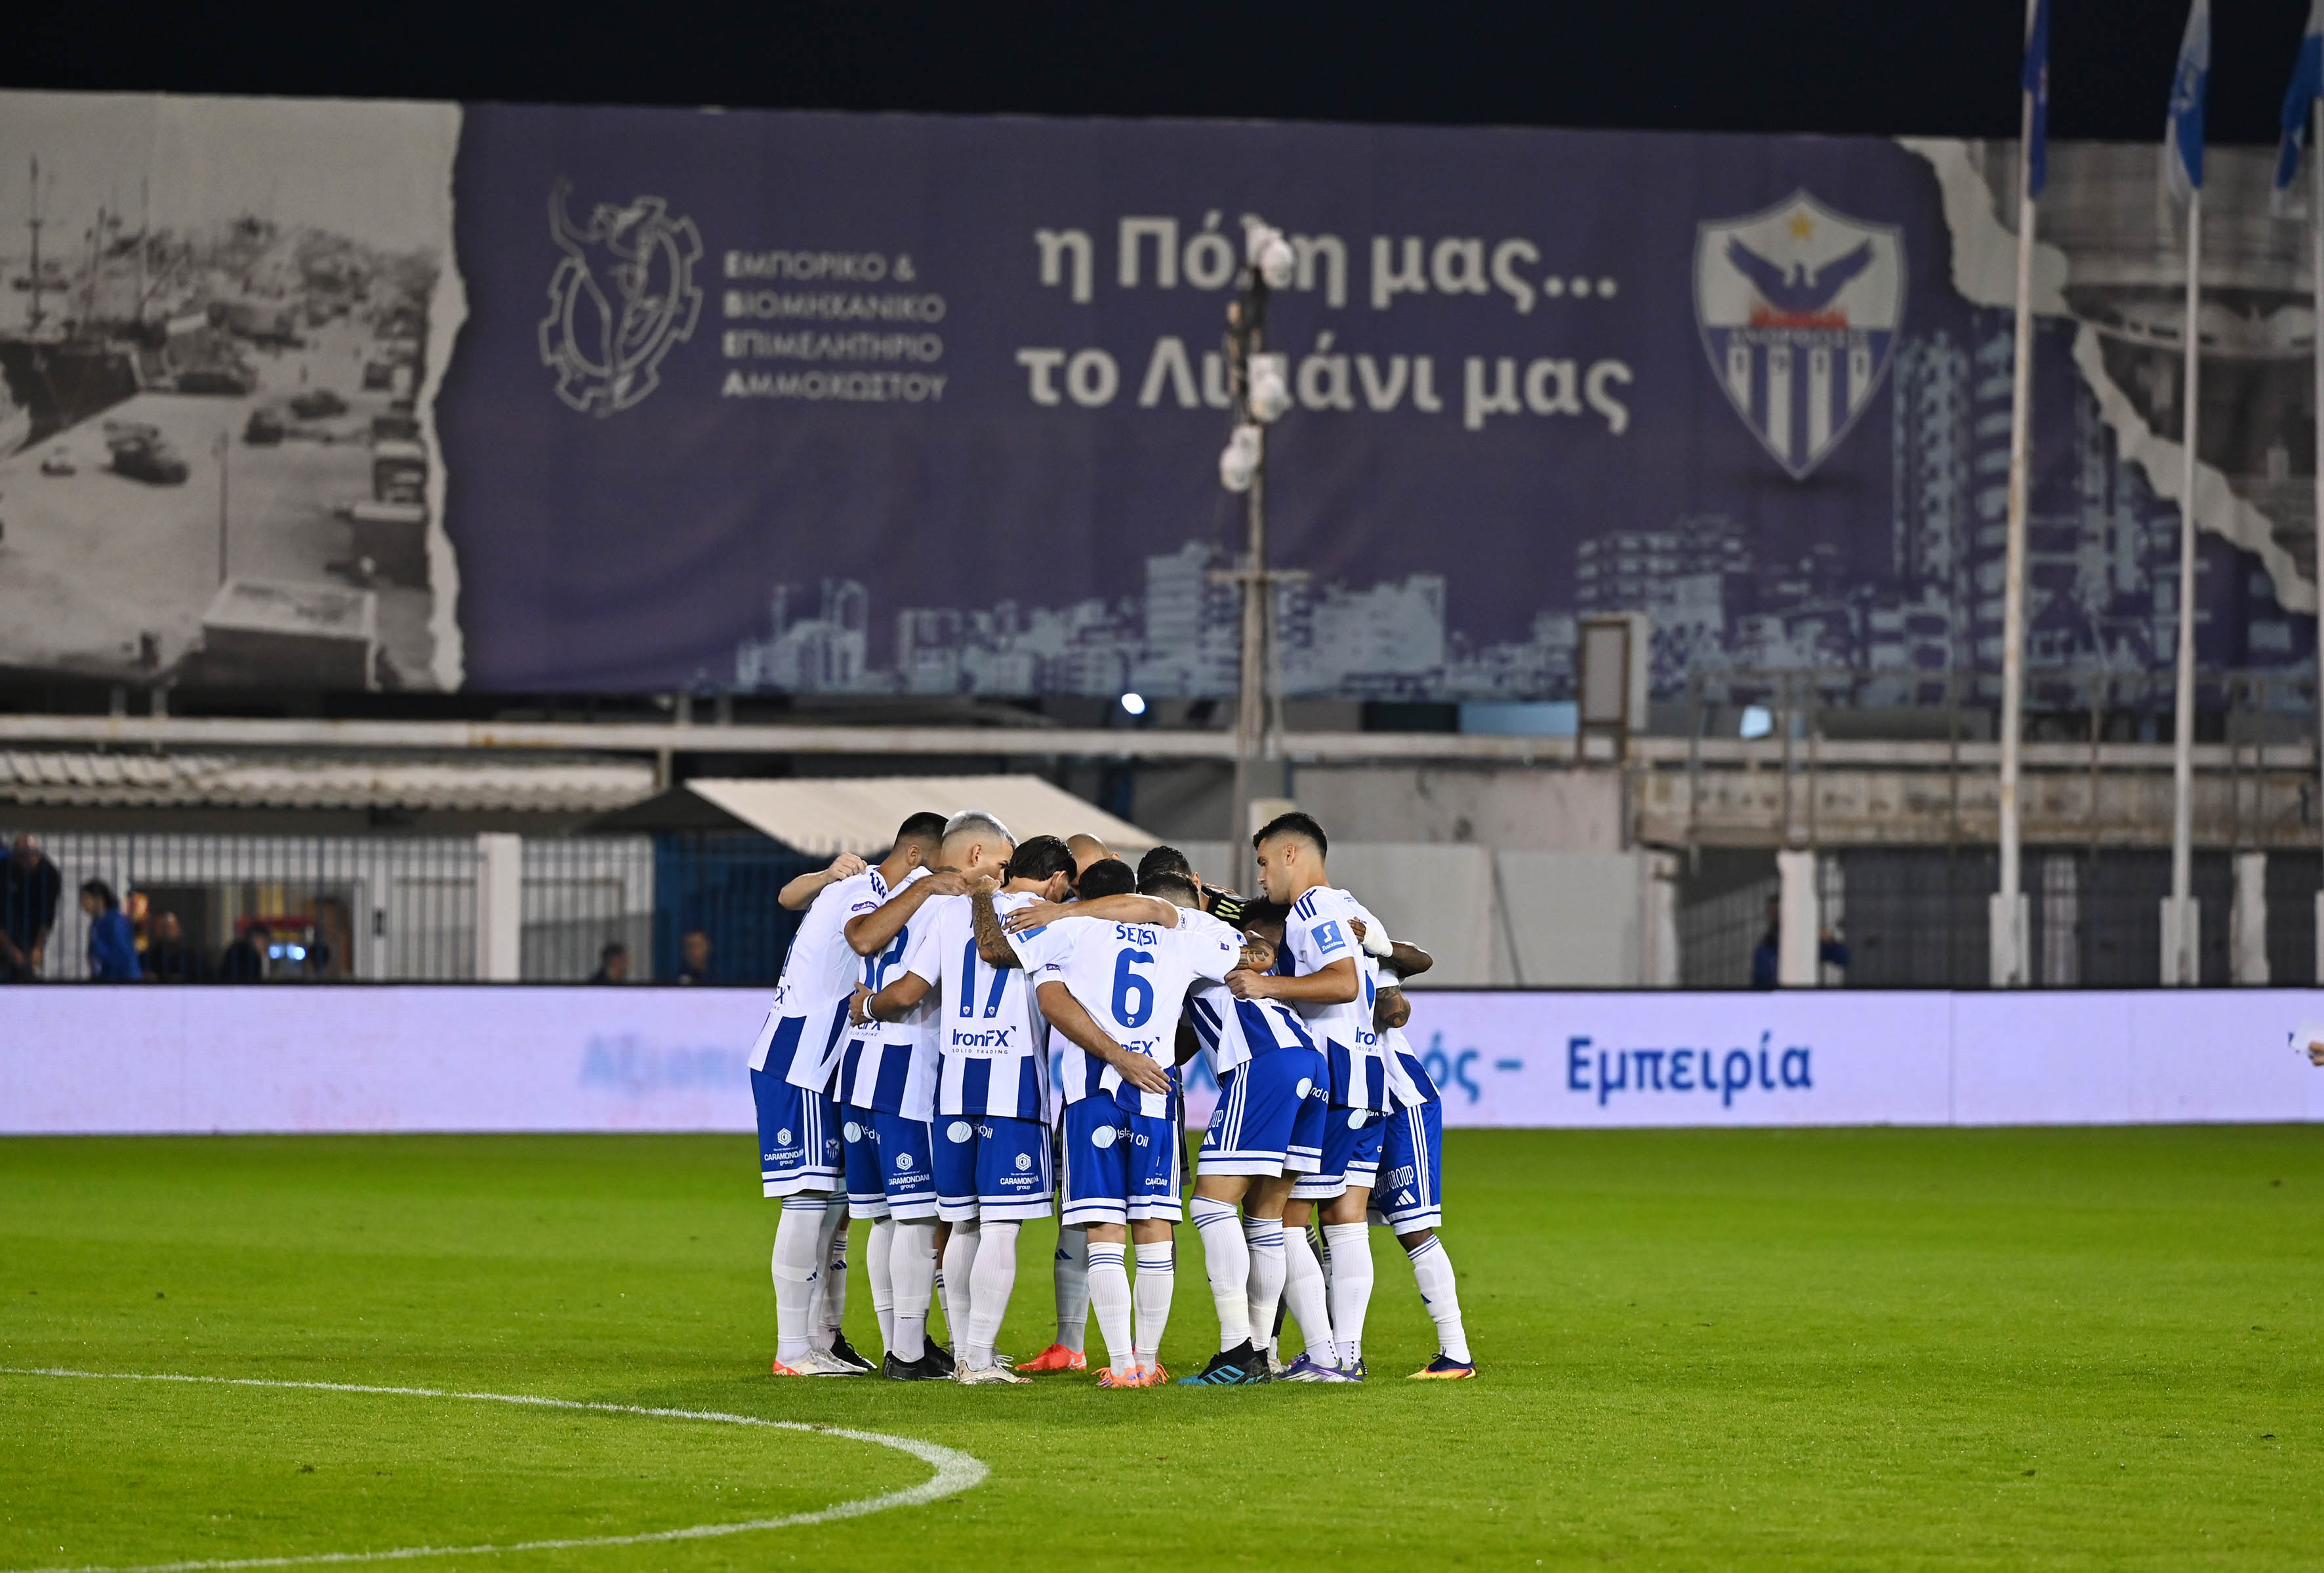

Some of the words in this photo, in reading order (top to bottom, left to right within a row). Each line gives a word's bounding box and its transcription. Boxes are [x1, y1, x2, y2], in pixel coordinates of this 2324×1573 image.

[893, 253, 917, 281] &
[1034, 226, 1093, 304] η
[1118, 210, 1347, 308] Πόη
[1372, 235, 1618, 313] μας...
[1016, 346, 1119, 407] το
[1139, 330, 1443, 413] Λιάνι
[1463, 358, 1634, 435] μας
[1111, 947, 1154, 1029] 6
[952, 1029, 1009, 1047] IronFX
[1568, 1030, 1813, 1109] Εμπειρία
[1135, 1134, 1149, 1148] Oil
